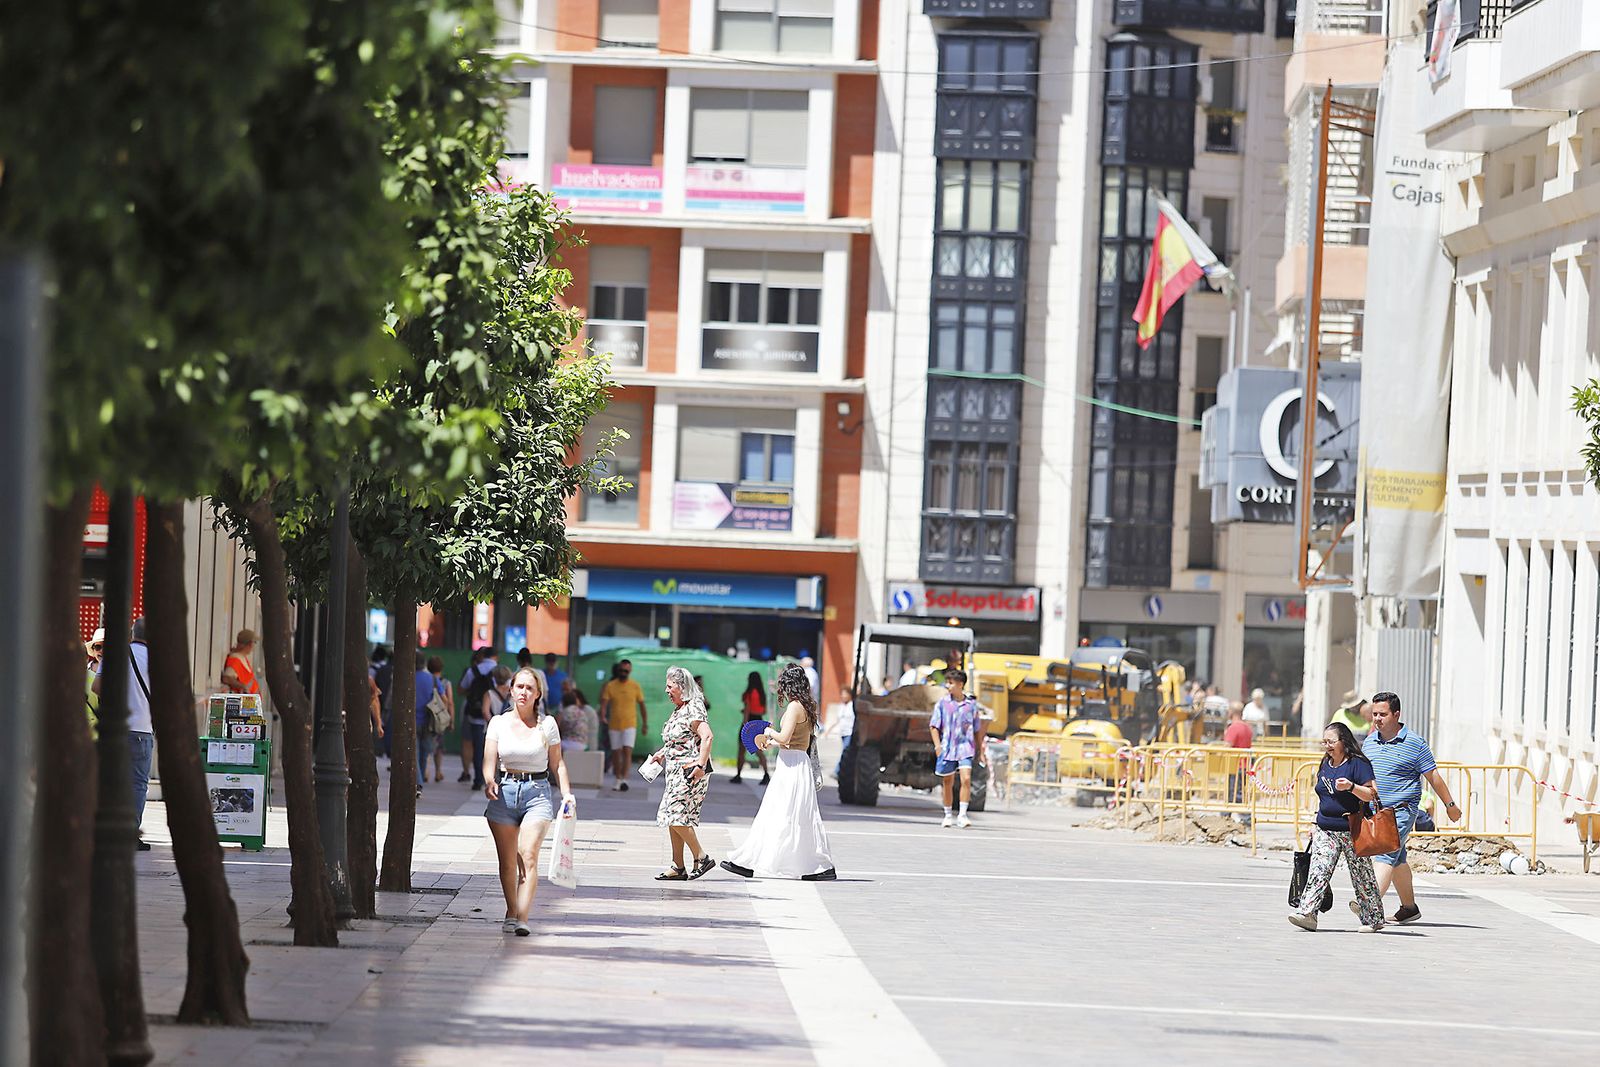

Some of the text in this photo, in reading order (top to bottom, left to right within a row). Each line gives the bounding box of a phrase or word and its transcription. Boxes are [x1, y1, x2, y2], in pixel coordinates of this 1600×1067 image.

[1392, 183, 1445, 206] Cajas
[677, 582, 731, 595] movistar
[925, 588, 1035, 613] Soloptical
